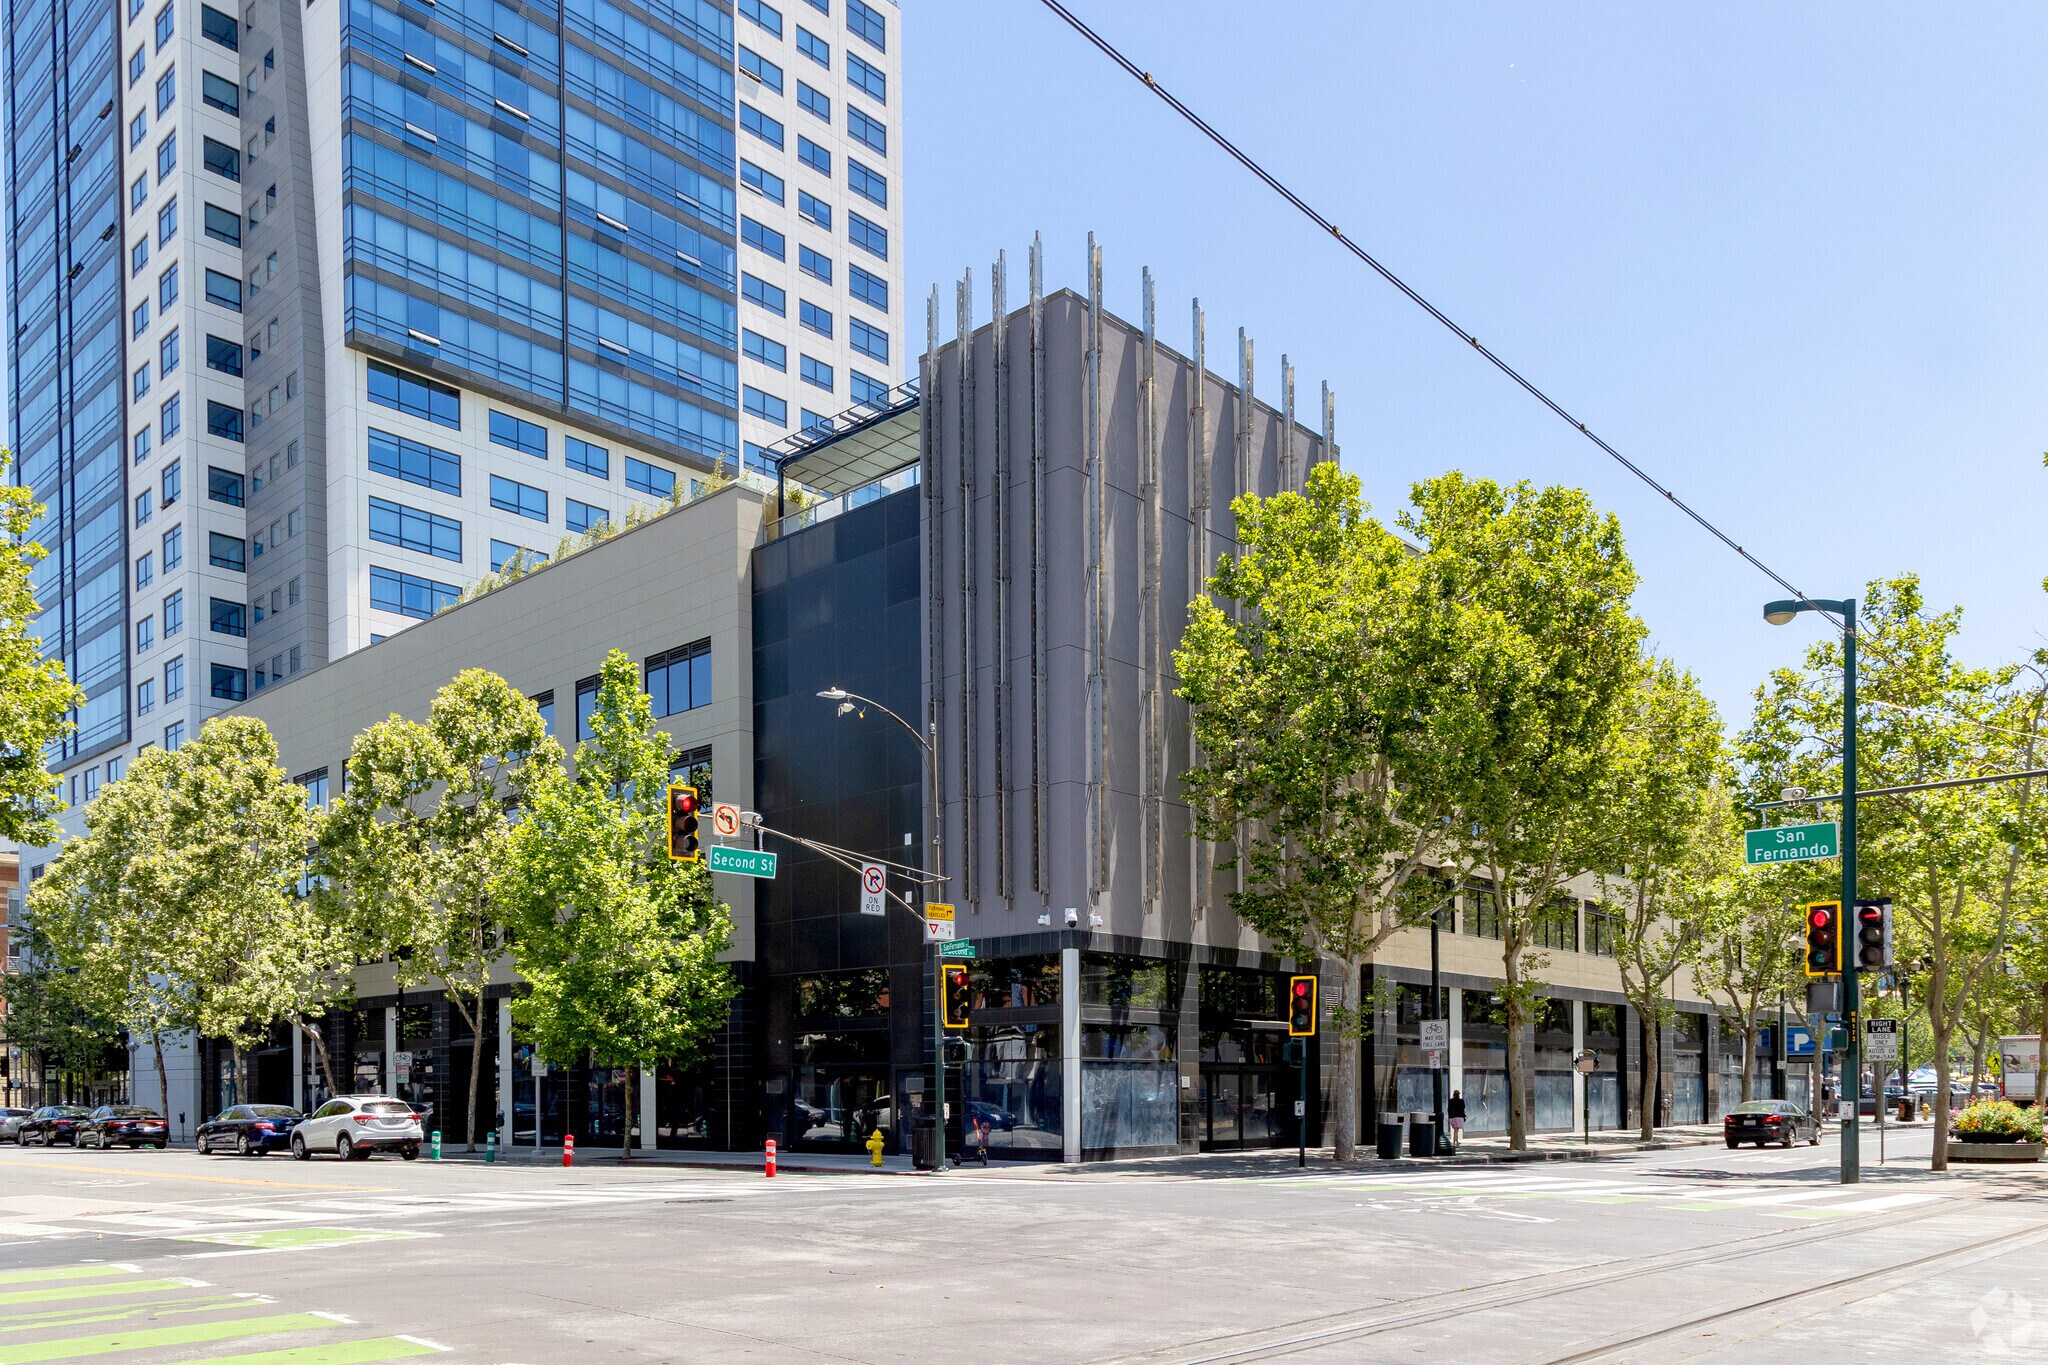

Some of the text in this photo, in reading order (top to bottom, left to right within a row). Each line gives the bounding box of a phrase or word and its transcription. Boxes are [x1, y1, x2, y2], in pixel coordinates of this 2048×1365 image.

[1775, 830, 1805, 844] San
[1754, 842, 1829, 862] Fernando
[713, 852, 773, 872] Second St
[865, 903, 881, 912] RED
[868, 896, 879, 904] ON
[1793, 1033, 1810, 1052] P
